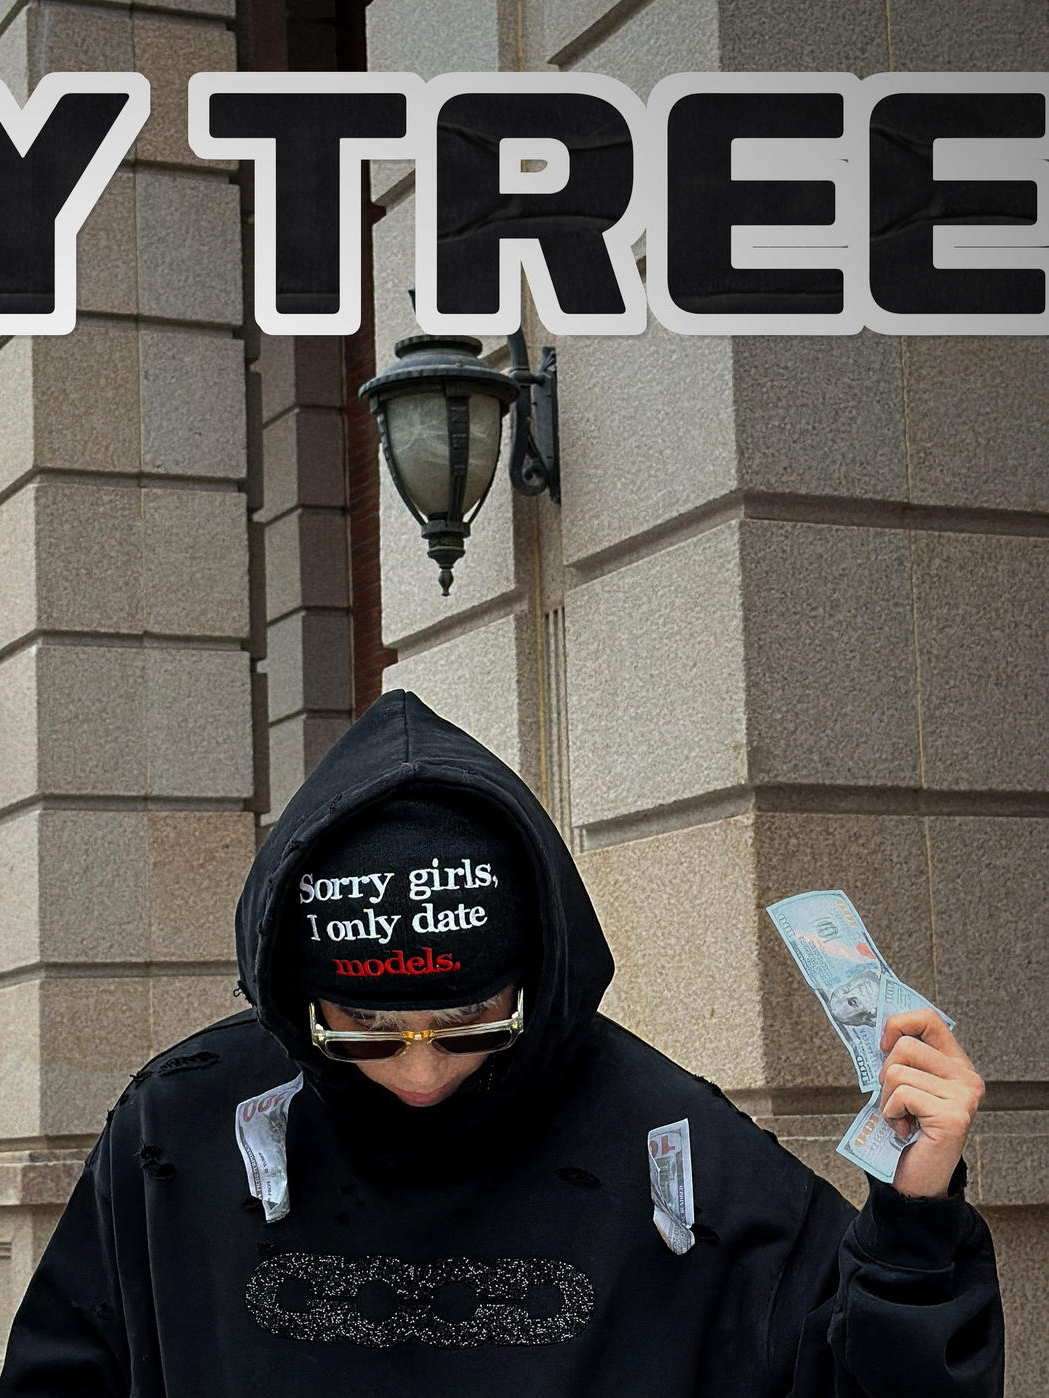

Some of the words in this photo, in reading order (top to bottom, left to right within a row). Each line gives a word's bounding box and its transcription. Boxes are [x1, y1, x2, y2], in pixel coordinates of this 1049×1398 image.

[299, 872, 395, 904] Sorry
[408, 857, 499, 901] girls,
[306, 914, 321, 941] I
[326, 908, 401, 944] only
[412, 903, 488, 934] date
[331, 947, 461, 977] models.
